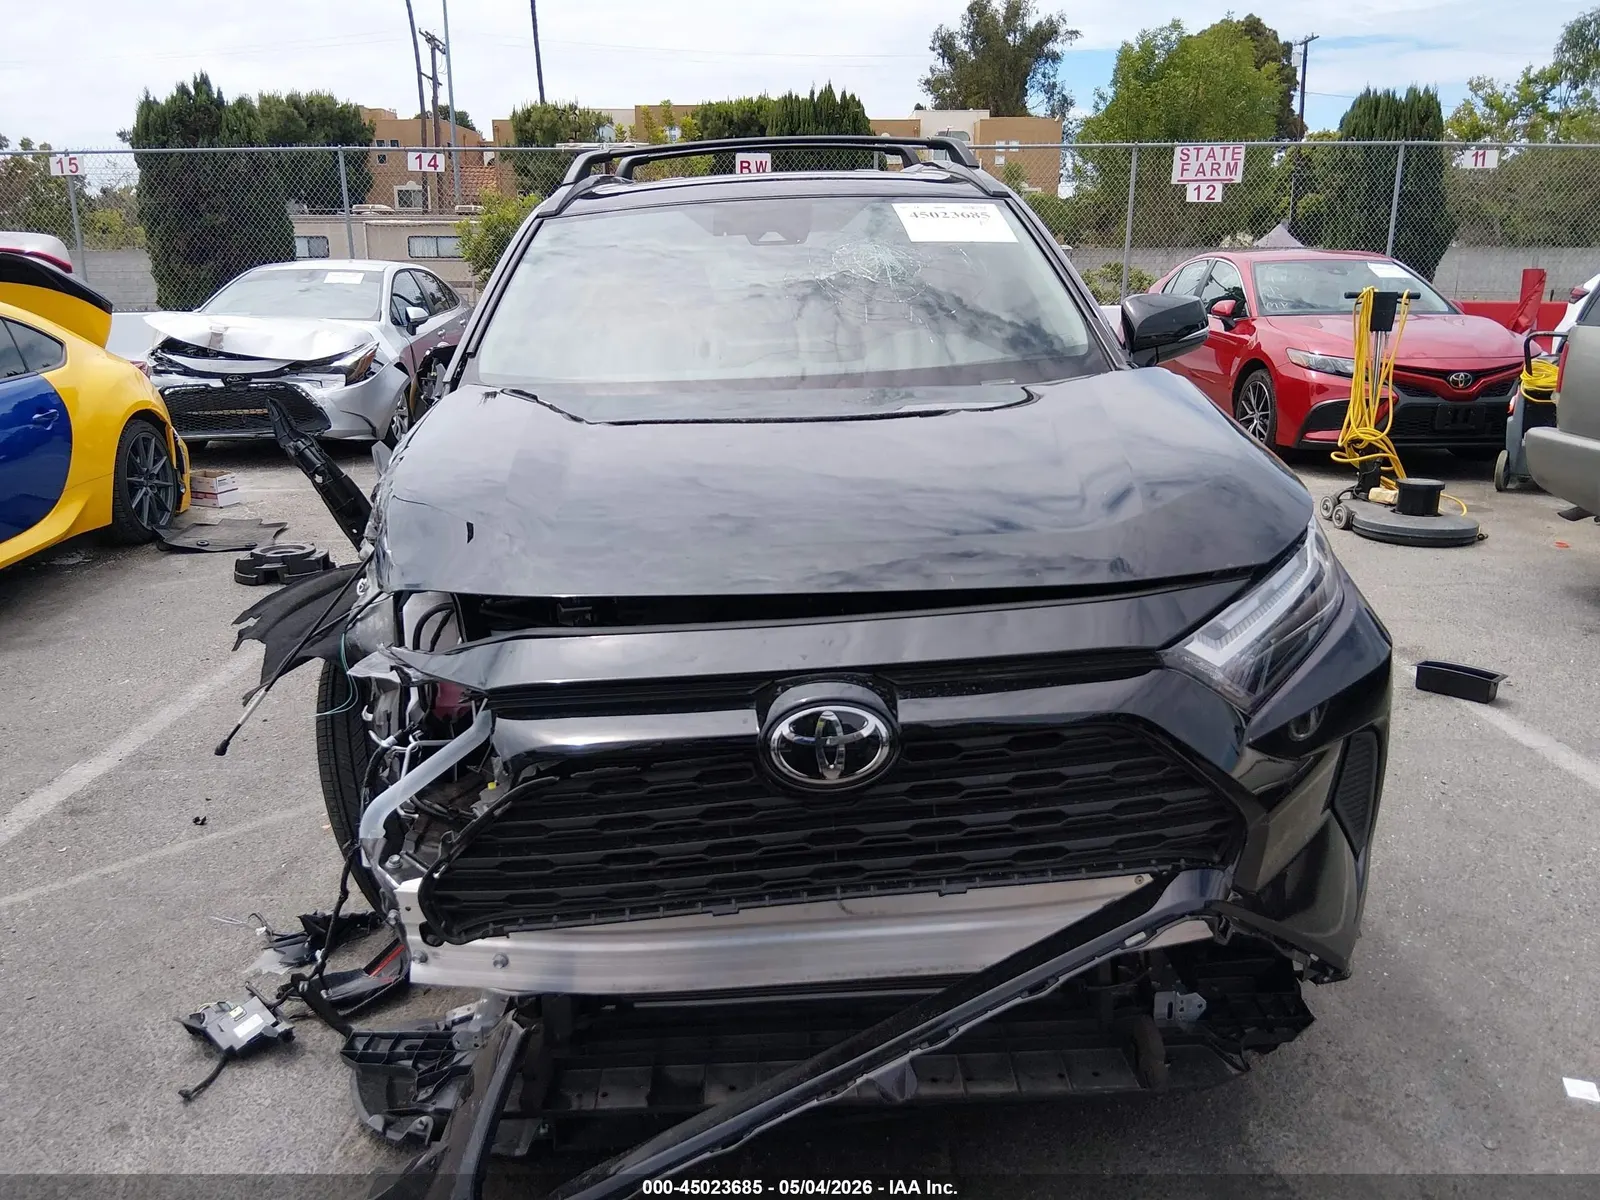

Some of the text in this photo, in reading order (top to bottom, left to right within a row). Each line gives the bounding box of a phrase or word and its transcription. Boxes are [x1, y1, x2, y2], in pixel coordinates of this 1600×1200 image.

[415, 153, 439, 170] 14
[1179, 146, 1243, 162] STATE
[1471, 150, 1487, 167] 11
[56, 157, 79, 174] 15
[1180, 162, 1239, 177] FARM
[1193, 184, 1217, 201] 12
[908, 210, 991, 220] 45023685
